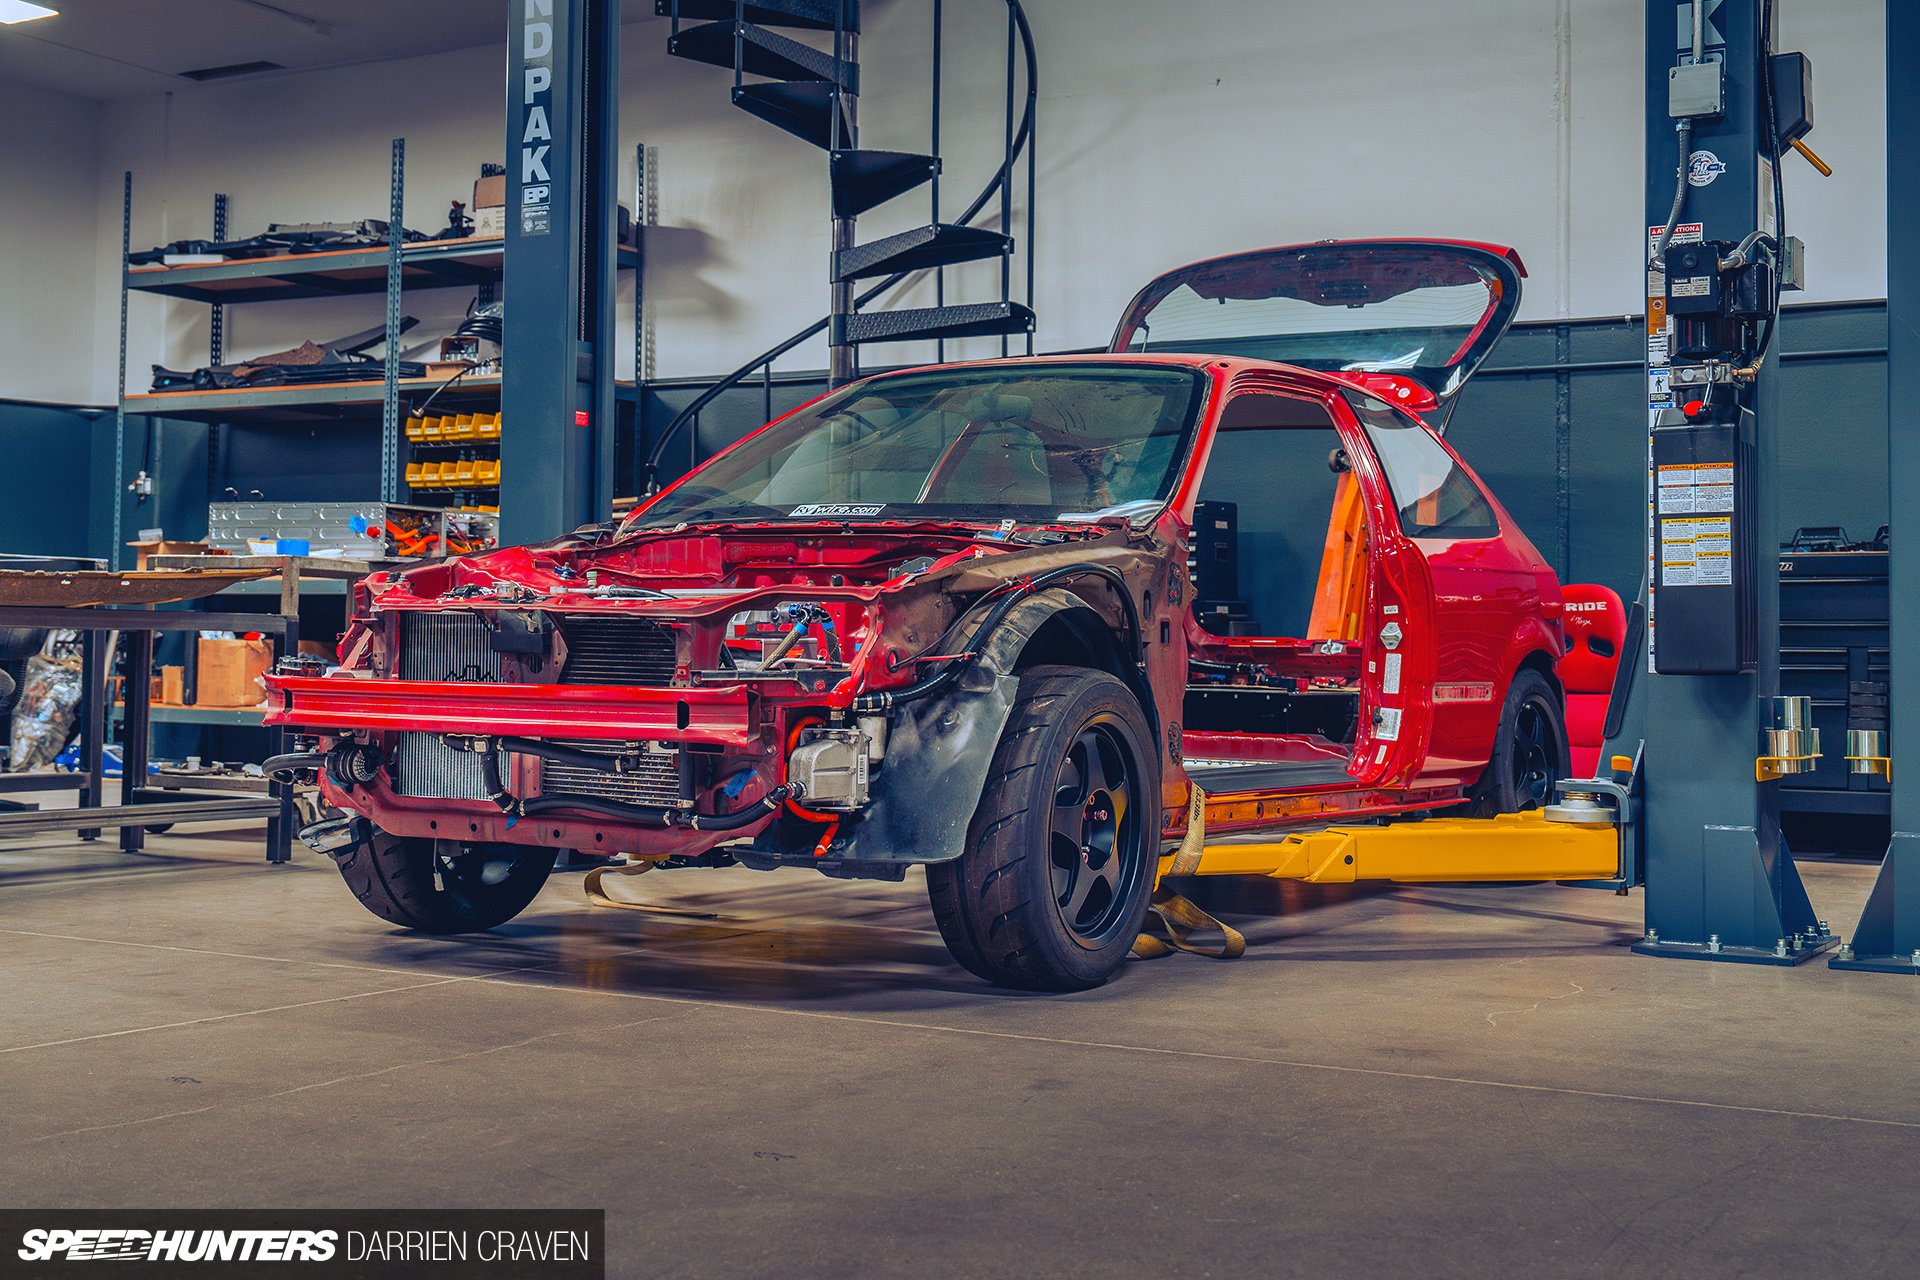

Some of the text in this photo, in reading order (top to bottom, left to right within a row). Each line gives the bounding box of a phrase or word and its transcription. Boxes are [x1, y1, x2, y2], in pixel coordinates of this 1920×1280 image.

[523, 186, 549, 204] BP
[1656, 226, 1695, 235] ATNTION
[1563, 601, 1607, 611] RIDE
